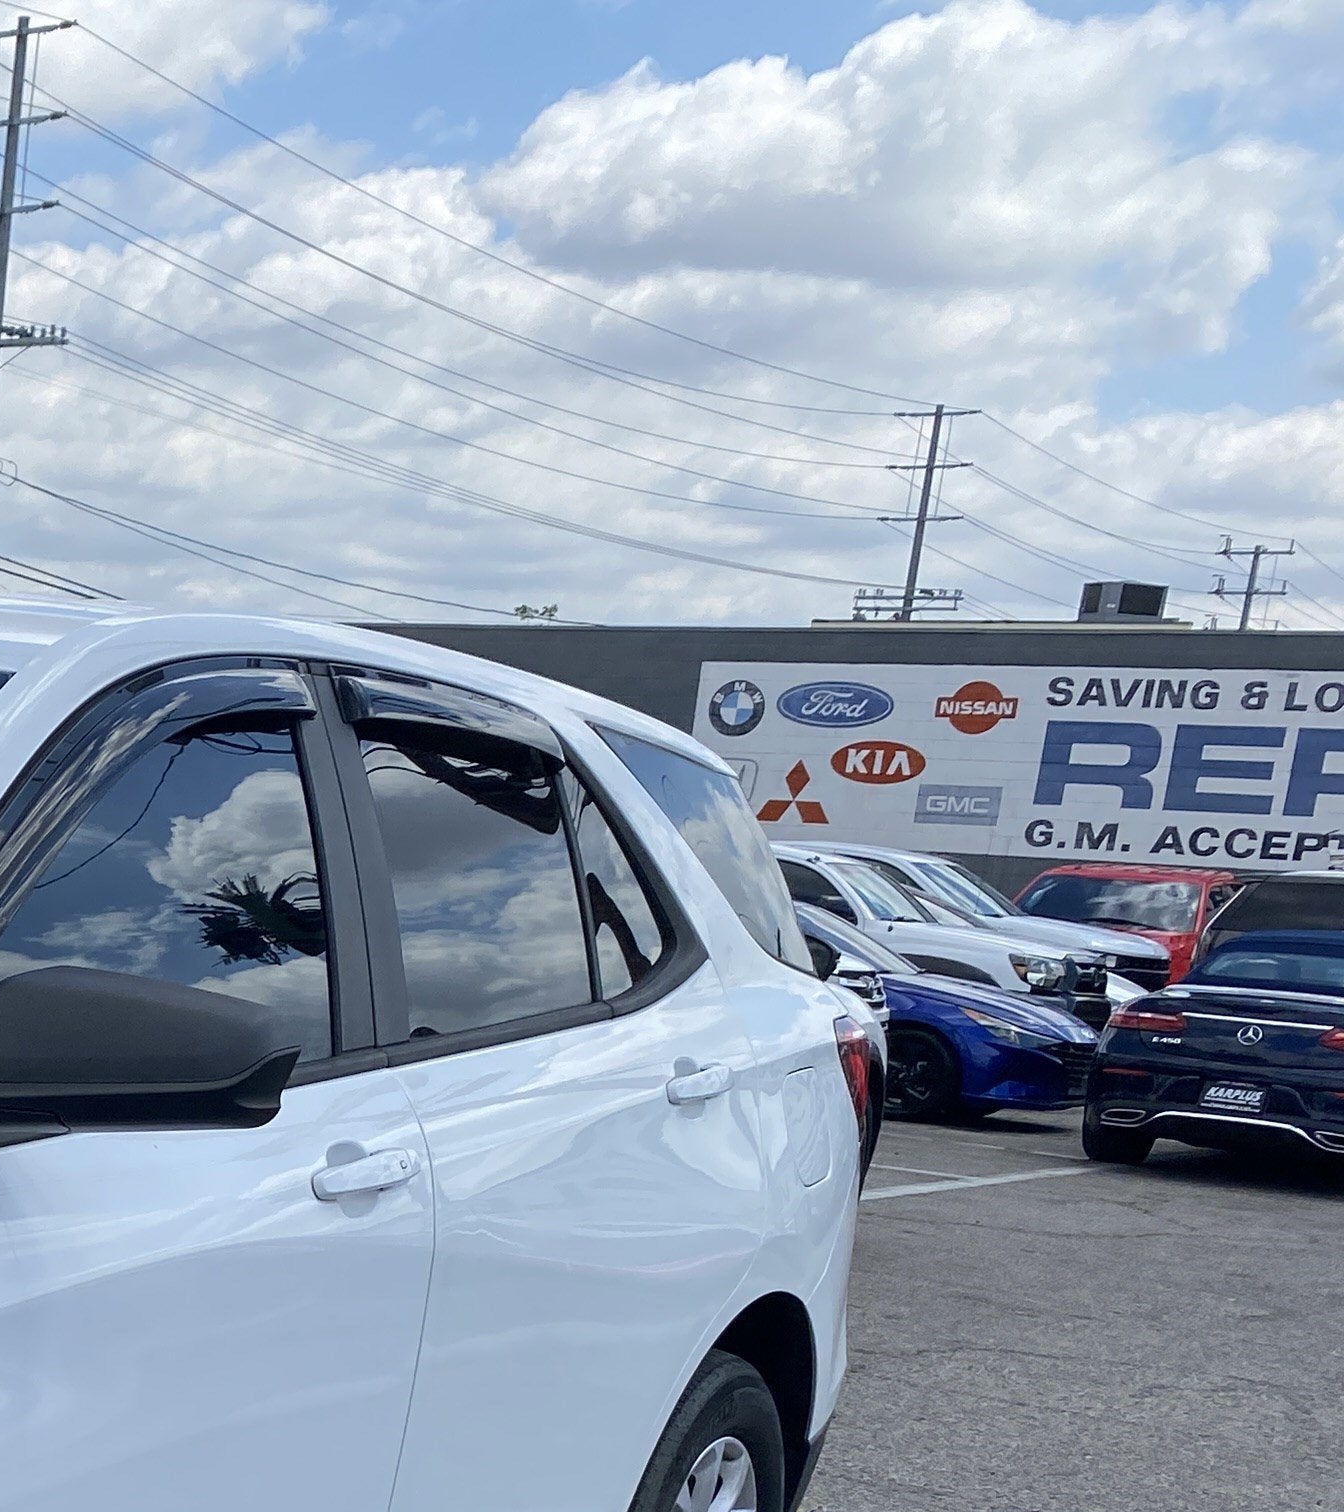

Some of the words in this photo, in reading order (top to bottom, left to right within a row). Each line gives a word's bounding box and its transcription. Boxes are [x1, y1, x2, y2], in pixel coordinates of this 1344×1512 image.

[801, 689, 869, 718] Ford
[1046, 676, 1221, 710] SAVING
[1240, 681, 1270, 710] &
[939, 700, 1014, 716] NISSAN
[845, 748, 911, 776] KIA
[925, 795, 991, 814] GMC
[1024, 819, 1131, 853] G.M.
[1205, 1086, 1263, 1102] KARPLUS
